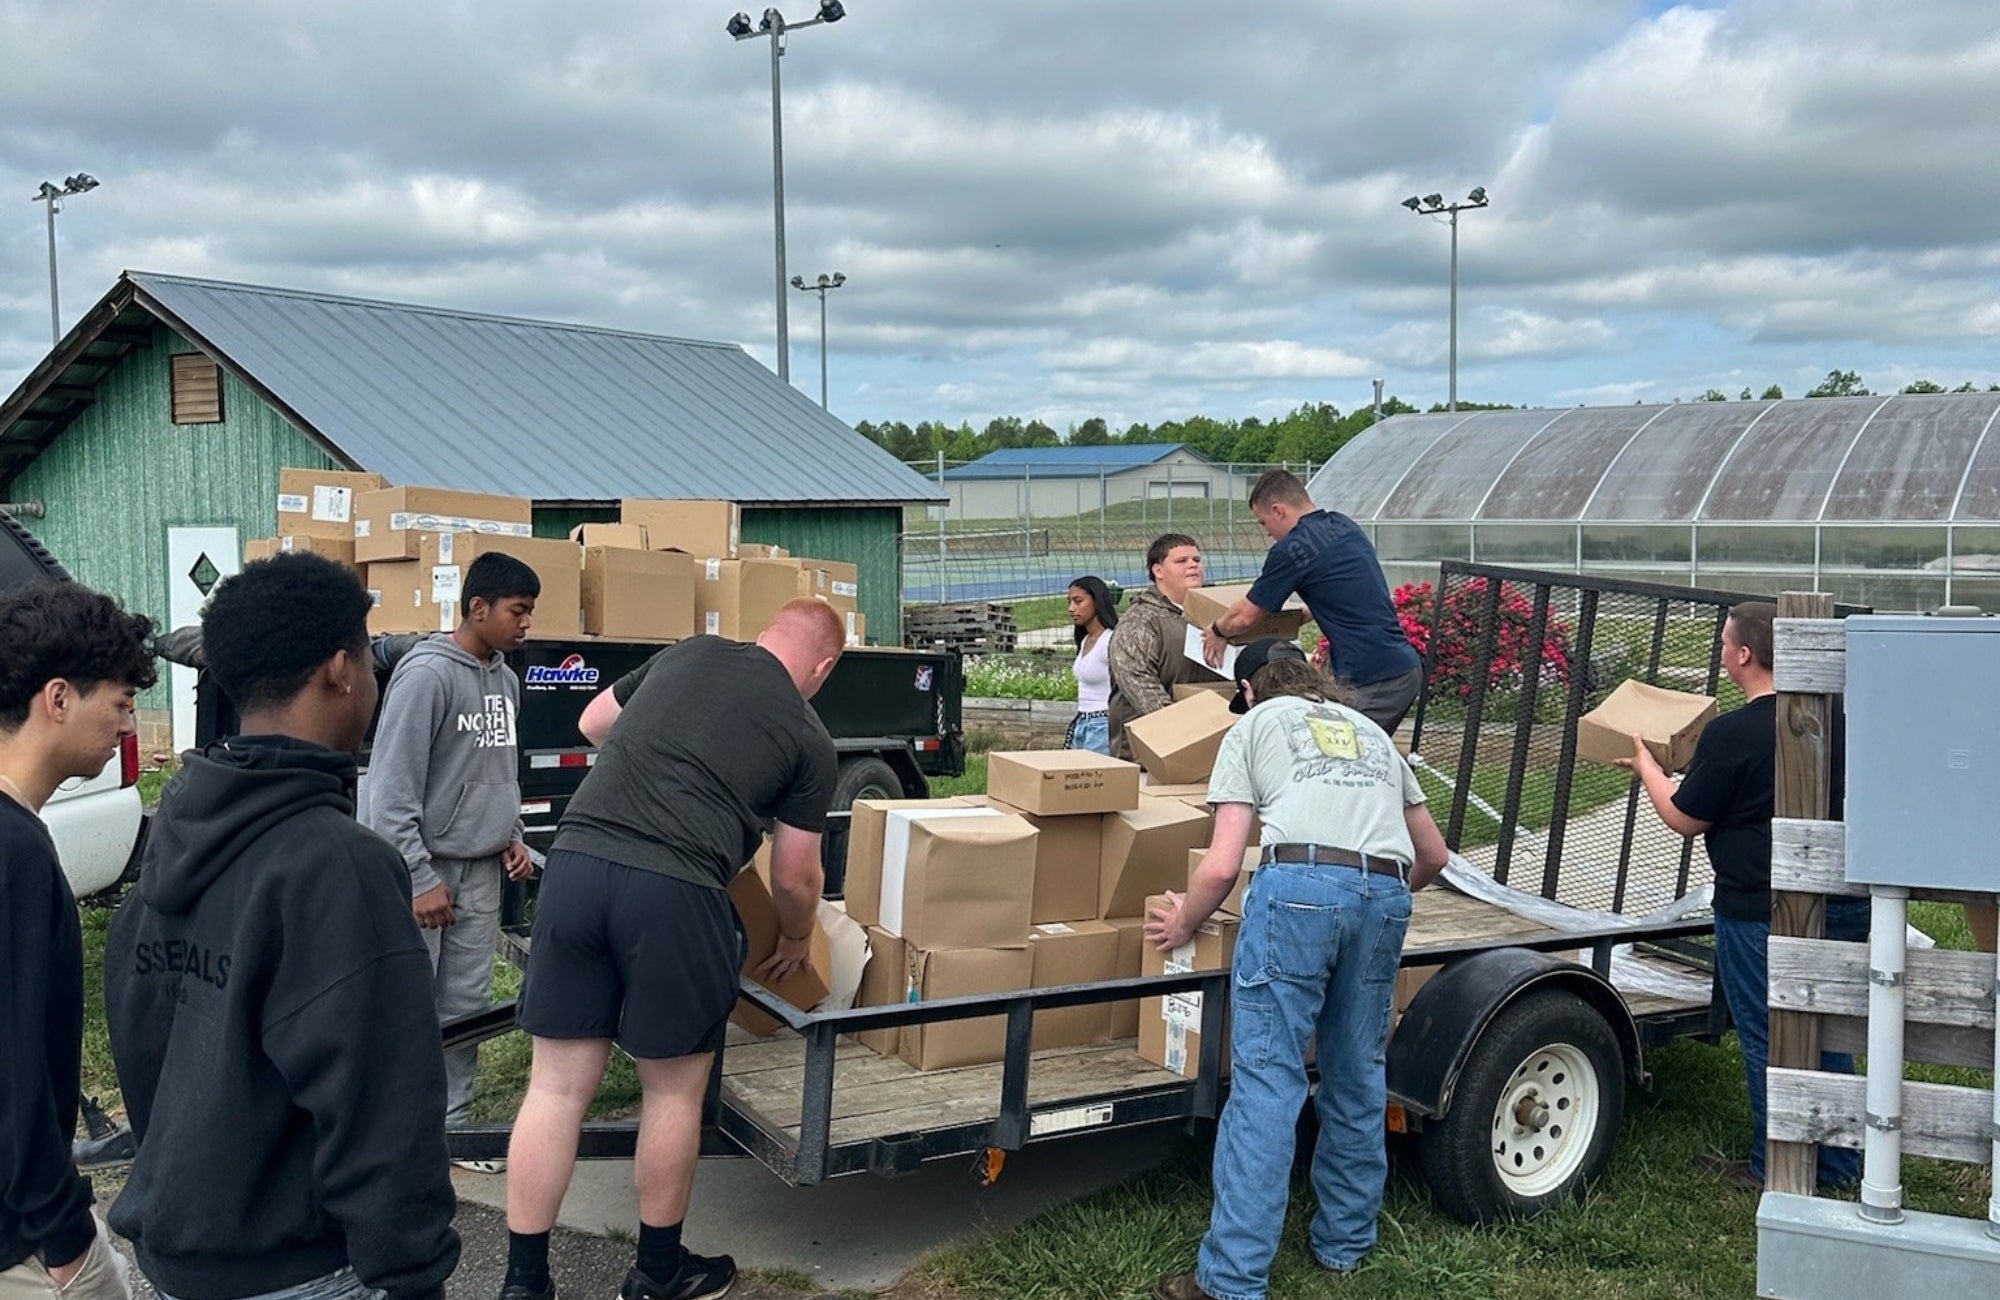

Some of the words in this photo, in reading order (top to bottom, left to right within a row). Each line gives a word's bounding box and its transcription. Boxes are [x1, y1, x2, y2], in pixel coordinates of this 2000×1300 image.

[525, 665, 599, 683] Hawke
[457, 712, 505, 731] NORH
[473, 729, 505, 748] ACE
[135, 939, 232, 990] SSEALS
